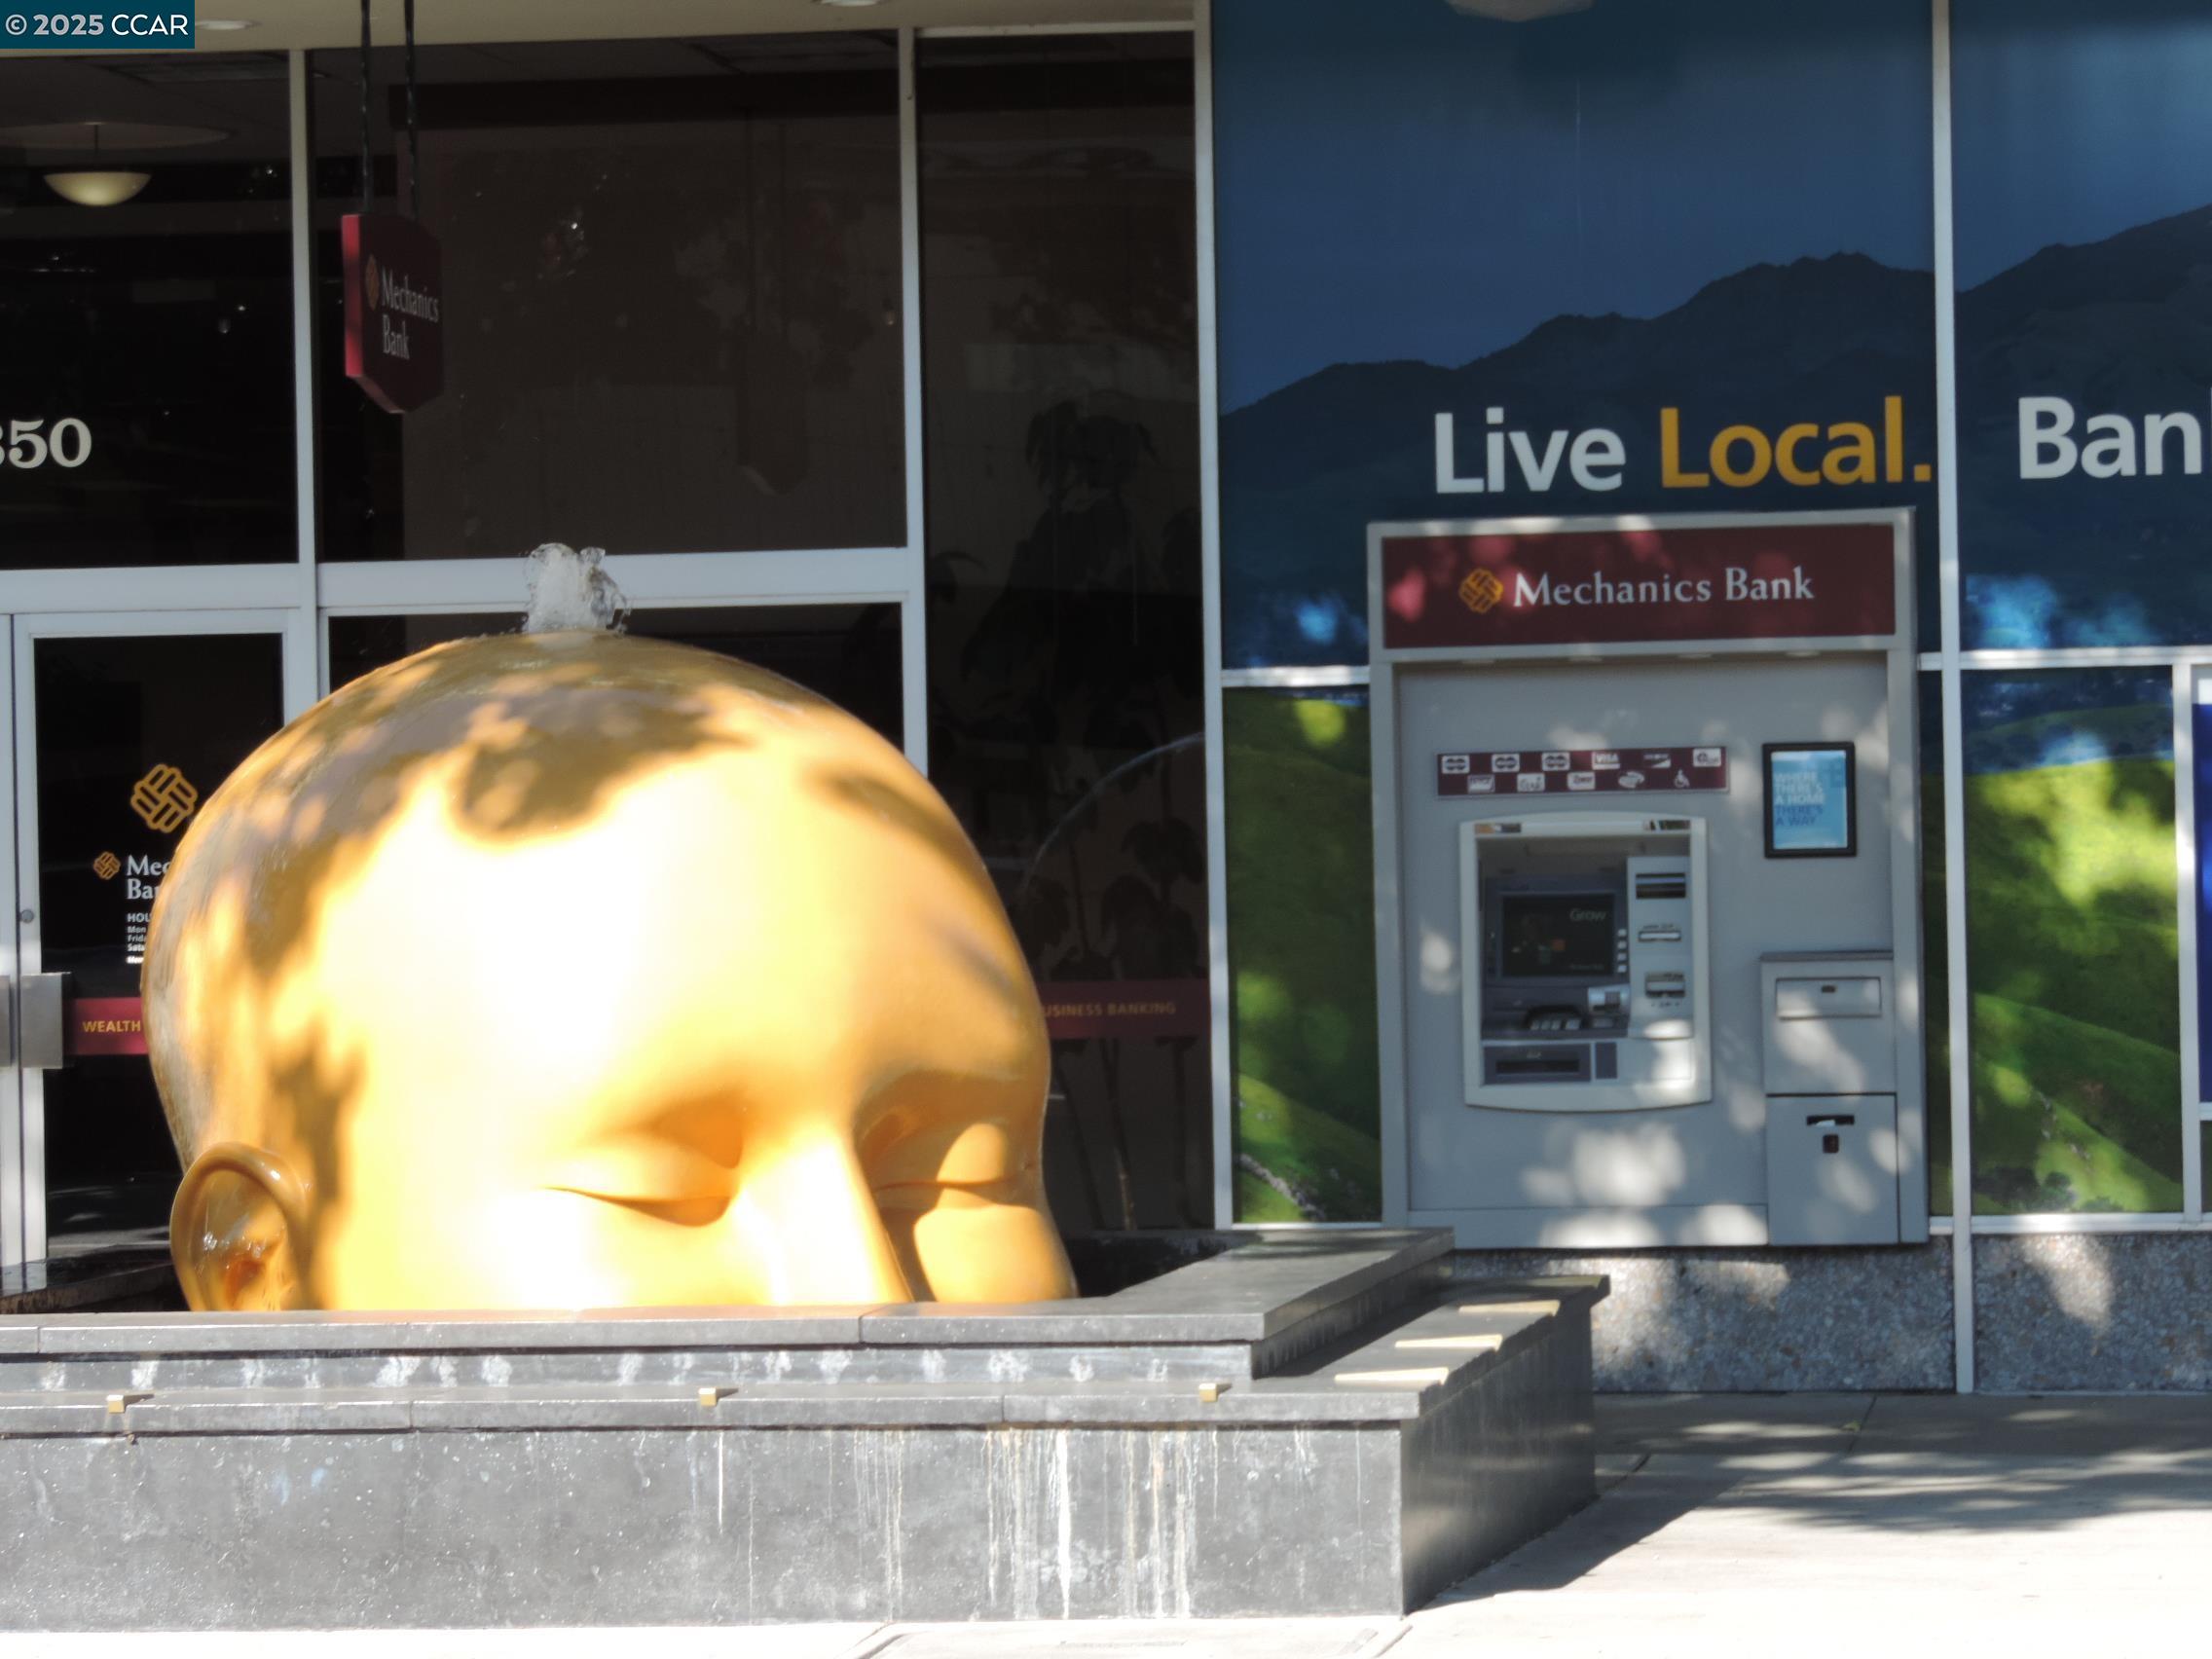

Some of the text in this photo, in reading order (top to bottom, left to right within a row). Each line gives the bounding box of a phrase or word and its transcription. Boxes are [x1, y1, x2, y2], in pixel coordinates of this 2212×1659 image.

[382, 265, 440, 323] Mechanics
[383, 313, 410, 360] Bank
[0, 417, 92, 469] 50
[1435, 387, 2212, 494] Live Local. Ban
[1513, 565, 1815, 608] Mechanics Bank
[1569, 908, 1607, 922] Grow
[82, 1020, 141, 1032] WEALTH
[1043, 1002, 1176, 1017] USINESS BANKING
